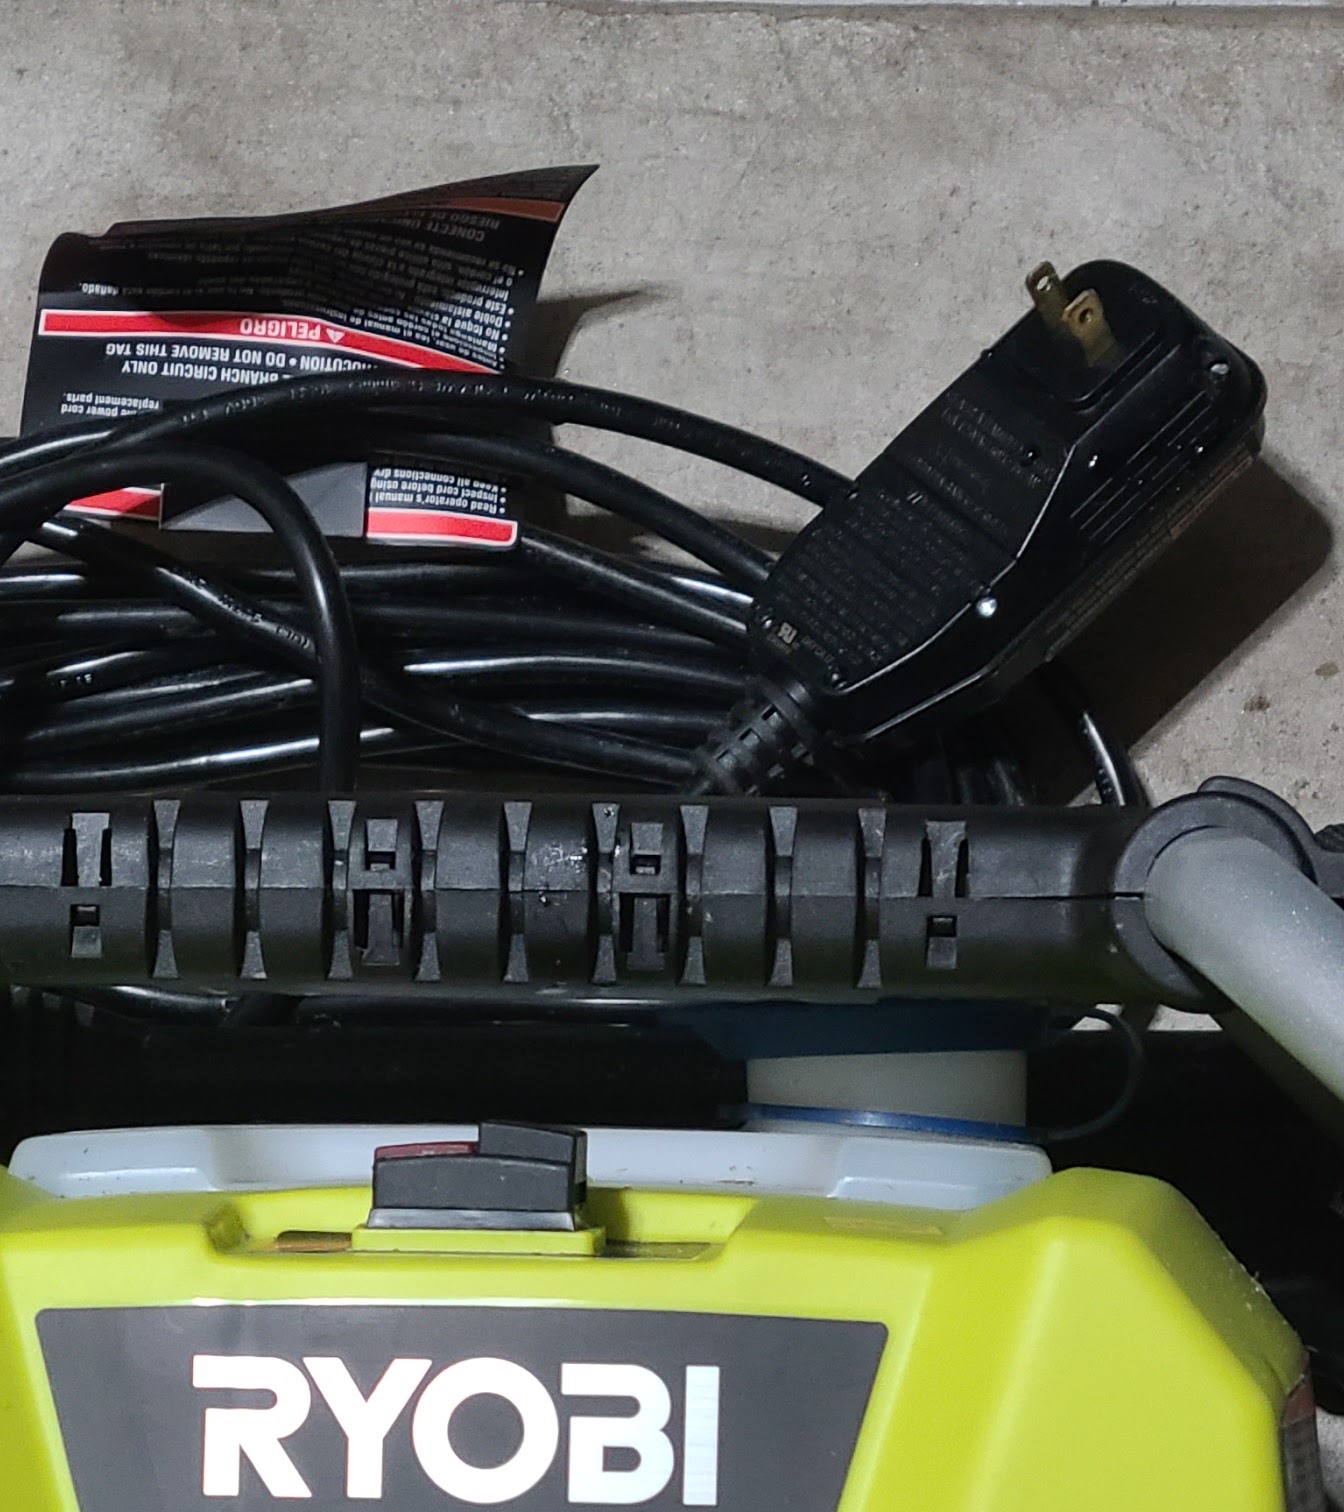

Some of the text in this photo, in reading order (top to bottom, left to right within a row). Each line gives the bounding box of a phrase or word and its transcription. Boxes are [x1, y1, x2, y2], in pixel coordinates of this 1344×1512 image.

[485, 299, 507, 315] Este
[364, 319, 401, 334] manual
[473, 310, 504, 328] Doble
[239, 318, 321, 340] PELIGRO
[454, 319, 483, 337] toque
[485, 327, 500, 341] No
[105, 343, 131, 355] TAG
[136, 343, 167, 357] THIS
[171, 344, 230, 362] REMOVE
[232, 349, 262, 365] NOT
[266, 352, 286, 368] DO
[121, 360, 279, 385] BRANCH CIRCUIT ONLY
[60, 404, 84, 415] cord
[63, 393, 159, 410] replacement parts.
[87, 406, 118, 417] power
[394, 469, 454, 484] connections
[458, 477, 470, 487] all
[370, 477, 498, 503] Inspect cord before using
[375, 491, 497, 515] Read operator's manual
[191, 1353, 721, 1507] RYOBI
